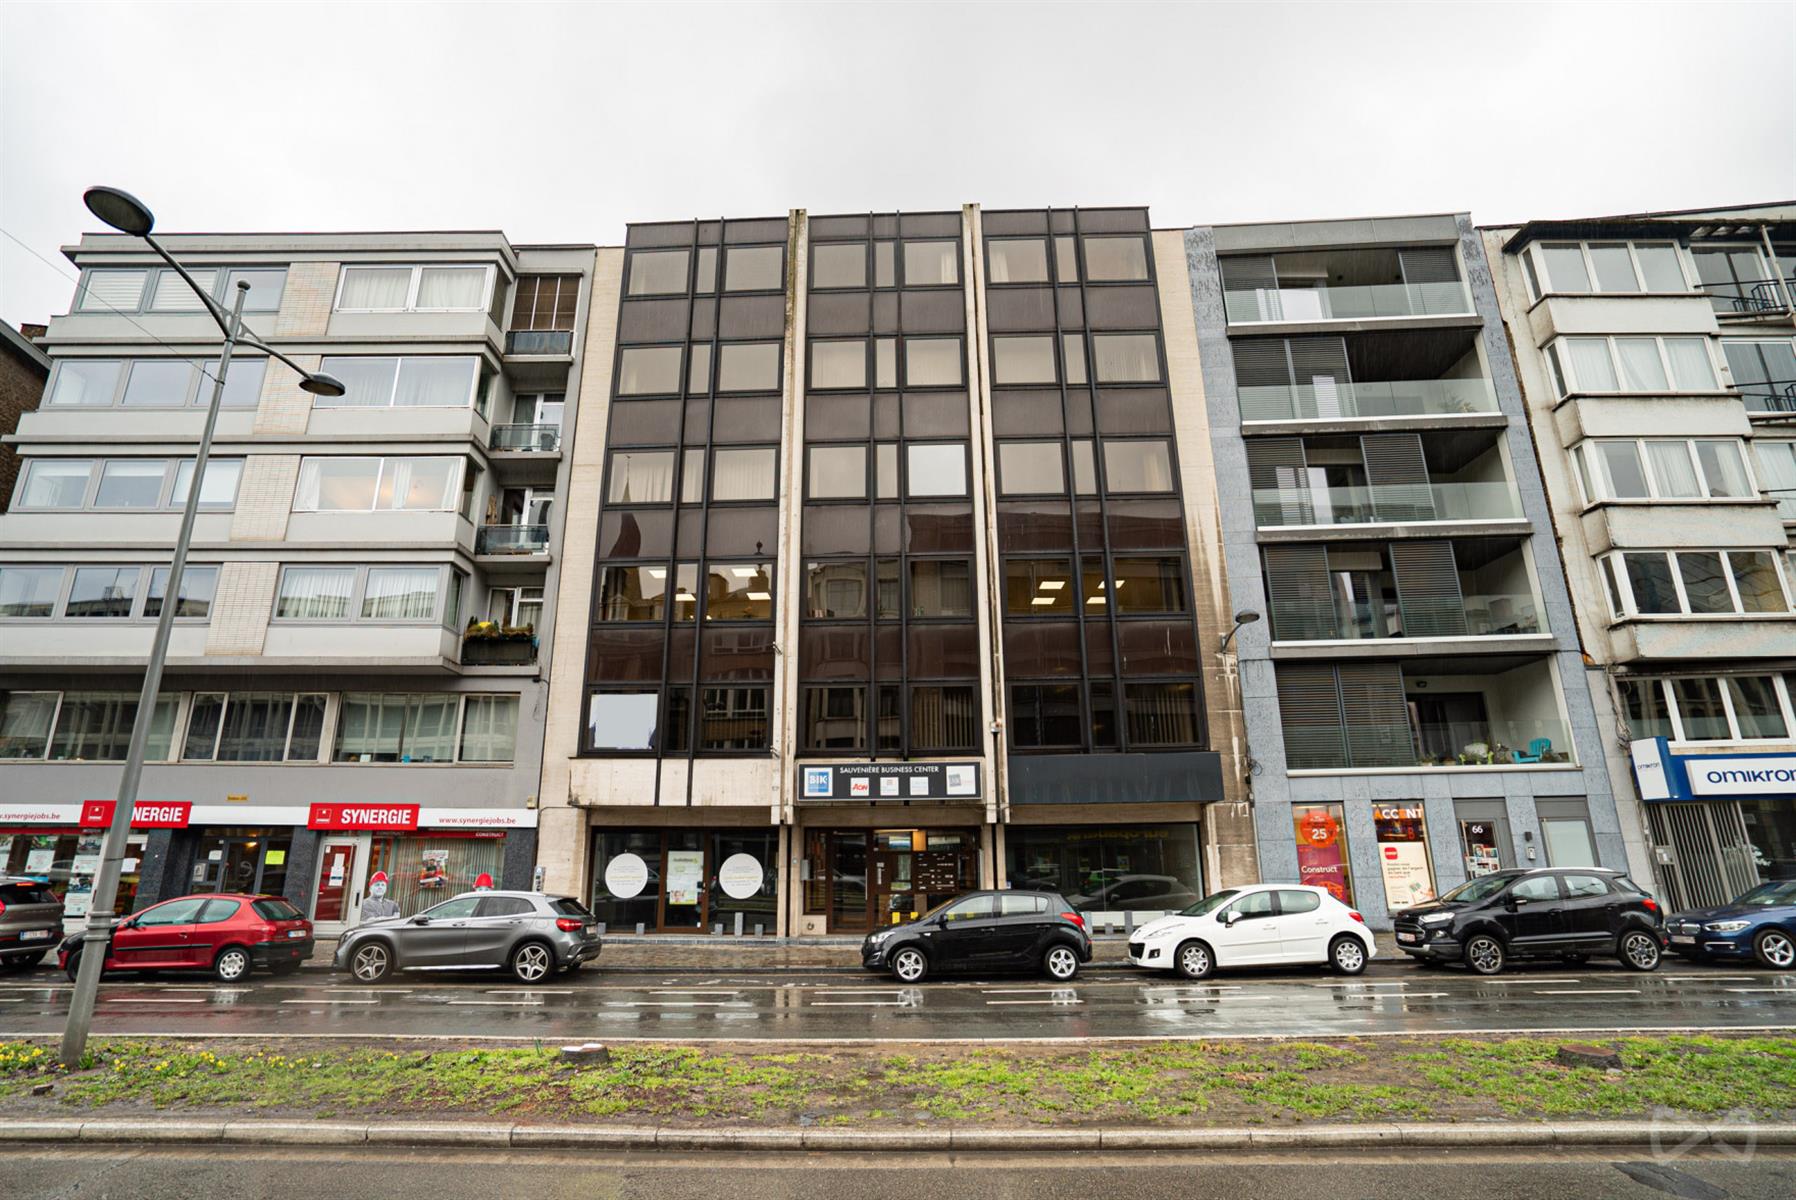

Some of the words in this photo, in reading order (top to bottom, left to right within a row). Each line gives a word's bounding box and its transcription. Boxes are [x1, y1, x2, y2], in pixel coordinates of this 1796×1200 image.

[840, 766, 880, 774] SAUVENIÈRE
[881, 766, 913, 774] BUSINESS
[914, 765, 939, 773] CENTER
[132, 806, 183, 822] NERGIE
[341, 808, 412, 824] SYNERGIE
[439, 816, 516, 825] www.synergiejobs.be
[1312, 828, 1327, 839] 25
[1472, 825, 1483, 834] 66
[1301, 865, 1338, 873] Construct
